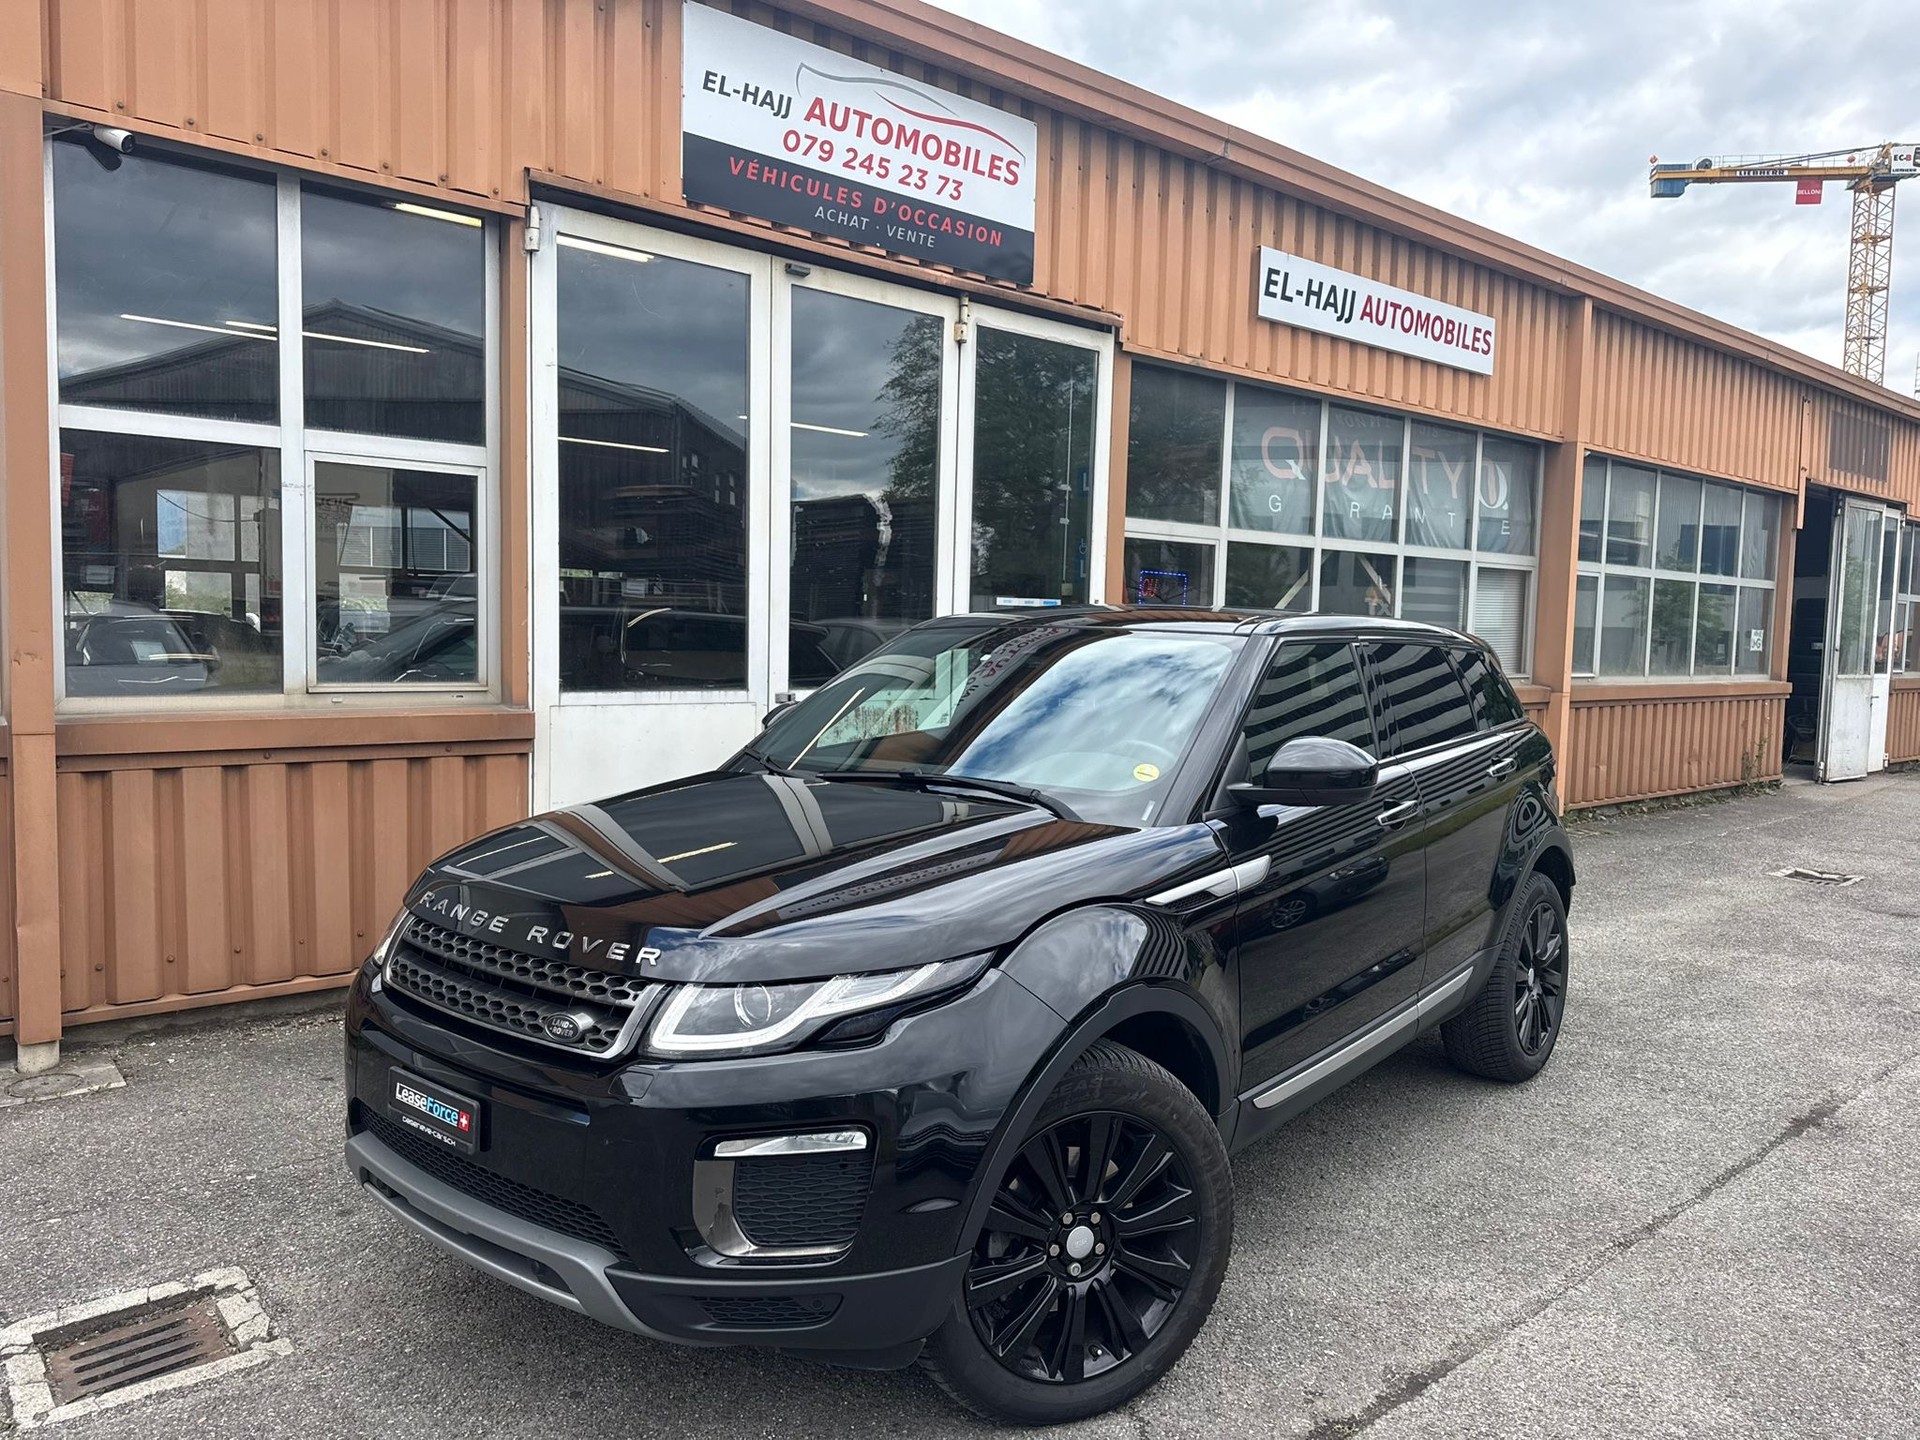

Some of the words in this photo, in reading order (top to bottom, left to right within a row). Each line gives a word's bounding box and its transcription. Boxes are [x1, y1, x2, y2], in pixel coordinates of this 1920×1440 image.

[702, 70, 793, 120] EL-HAJJ
[803, 97, 1021, 187] AUTOMOBILES
[782, 129, 835, 162] 079
[842, 147, 891, 179] 245
[898, 164, 927, 191] 23
[936, 175, 964, 201] 73
[728, 156, 864, 209] VÉHICULES
[873, 196, 1003, 247] D'OCCASION
[814, 205, 870, 231] ACHAT
[886, 225, 936, 249] VENTE
[1264, 267, 1356, 324] EL-HAJJ
[1360, 294, 1492, 355] AUTOMOBILES
[419, 891, 509, 933] RANGE
[526, 926, 662, 966] ROVER
[551, 1026, 574, 1038] ROVER
[552, 1018, 570, 1029] LAND
[395, 1081, 459, 1124] LeaseForce
